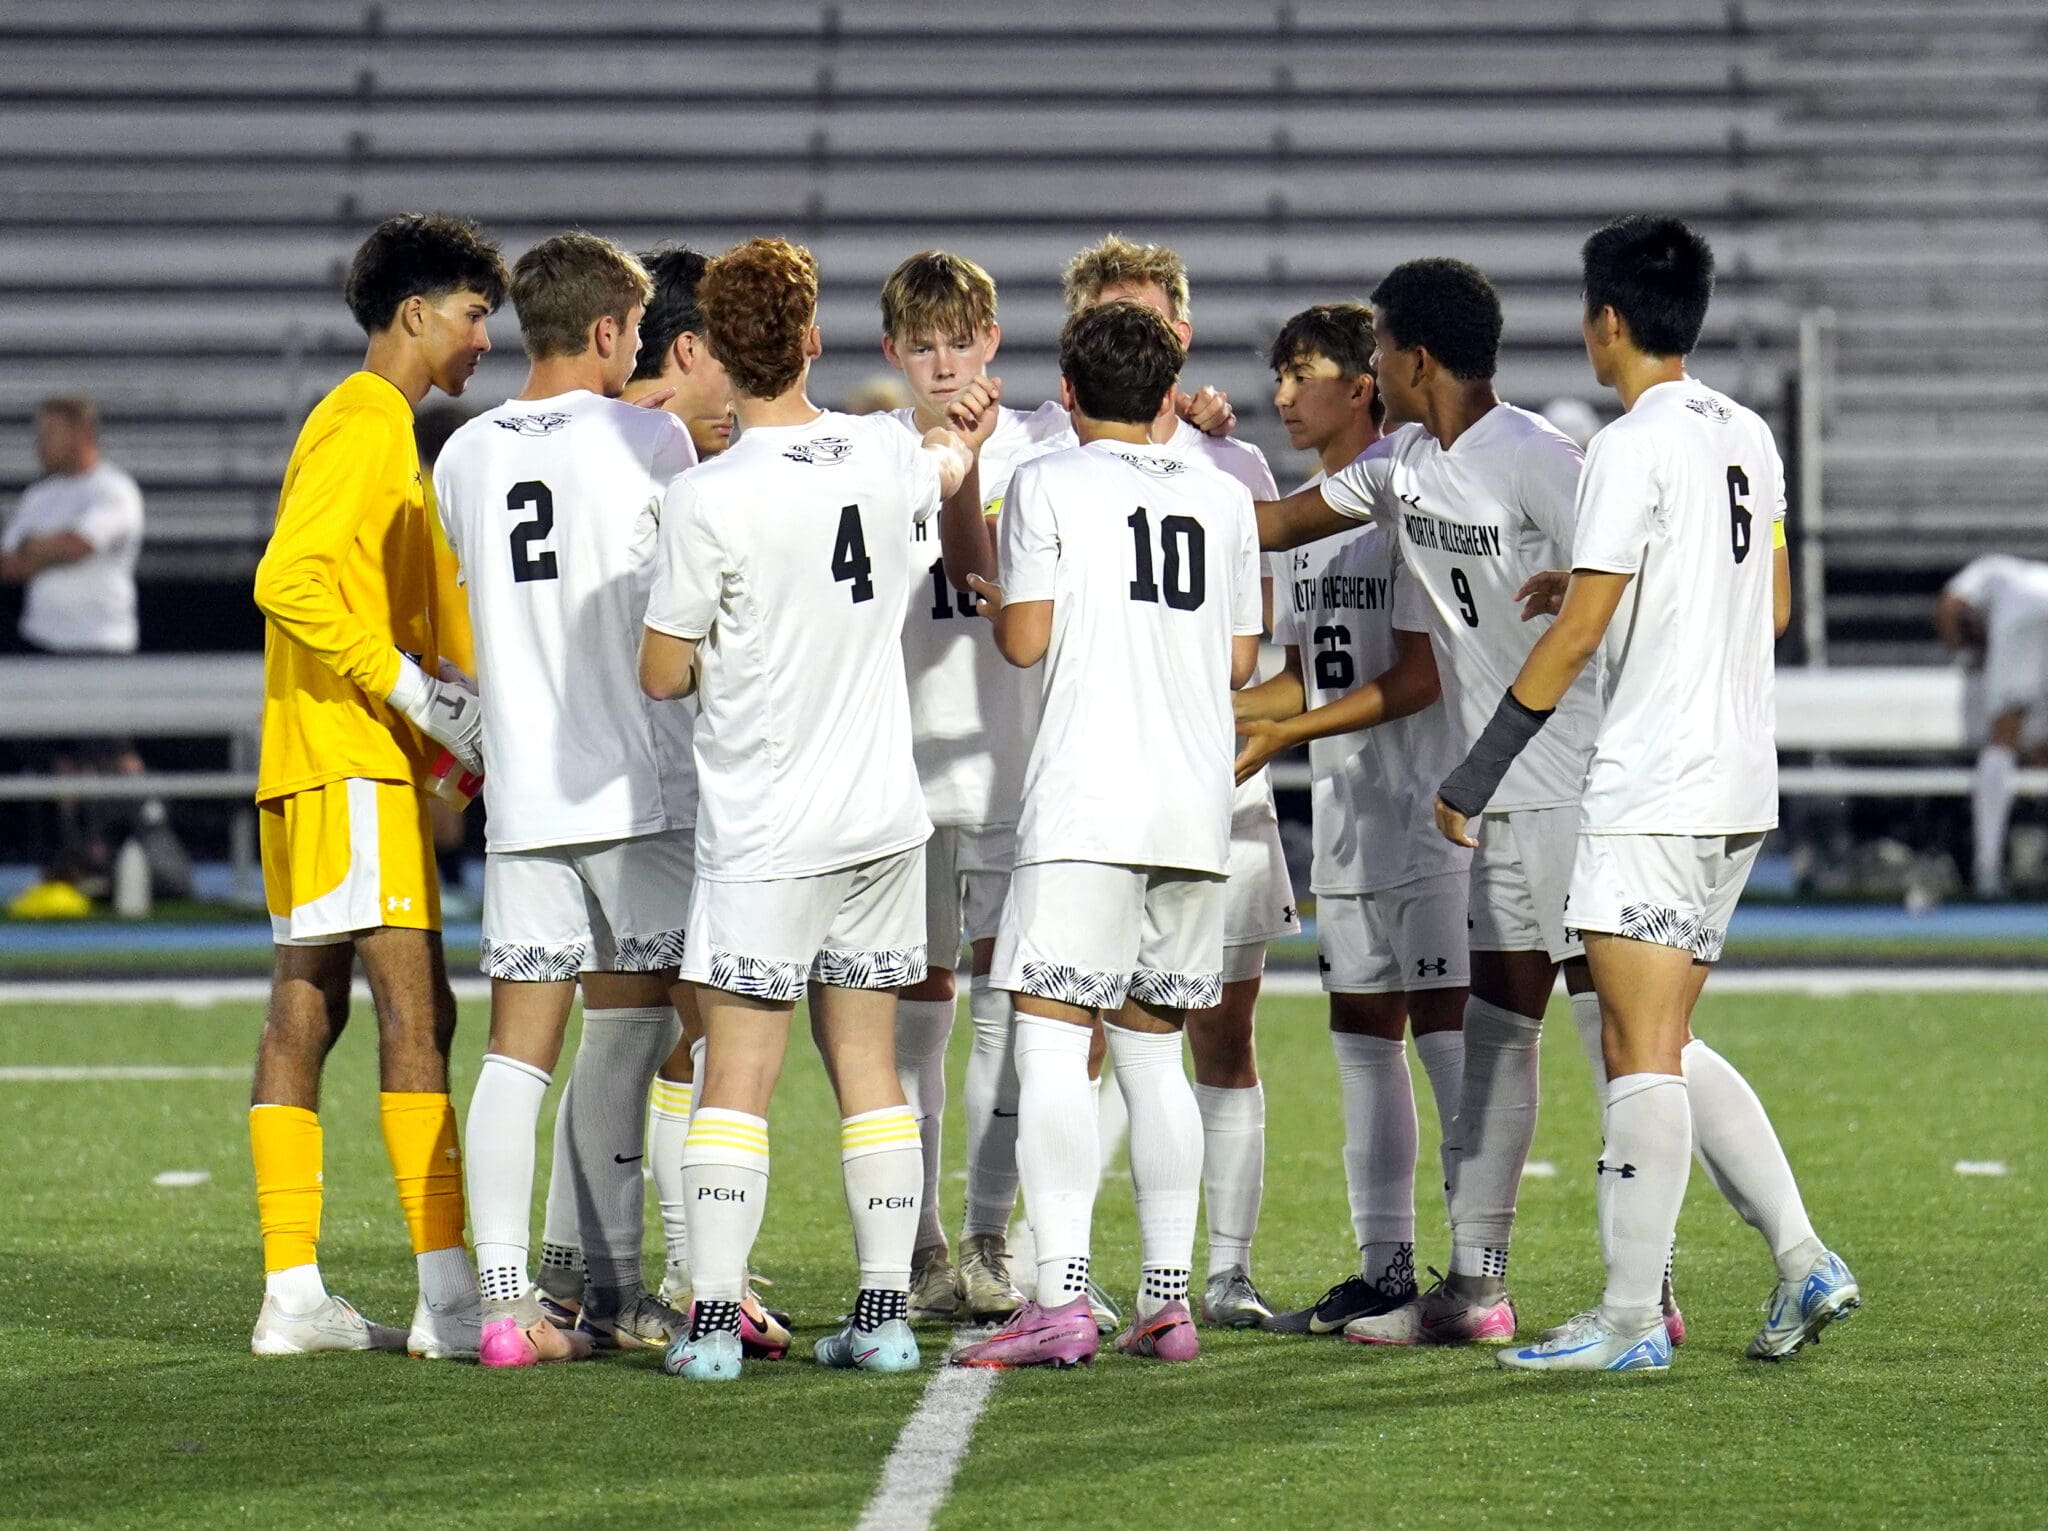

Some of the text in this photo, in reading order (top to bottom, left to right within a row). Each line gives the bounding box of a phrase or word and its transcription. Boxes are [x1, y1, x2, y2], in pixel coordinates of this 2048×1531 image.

[506, 480, 559, 583] 2
[1403, 513, 1501, 556] NORTH ALLEGHENY
[1726, 465, 1753, 564] 6
[831, 504, 874, 604] 4
[1127, 506, 1206, 612] 10
[1322, 575, 1387, 610] ALEGHENY
[1450, 567, 1479, 628] 9
[697, 1187, 745, 1202] PGH
[868, 1196, 914, 1210] PGH
